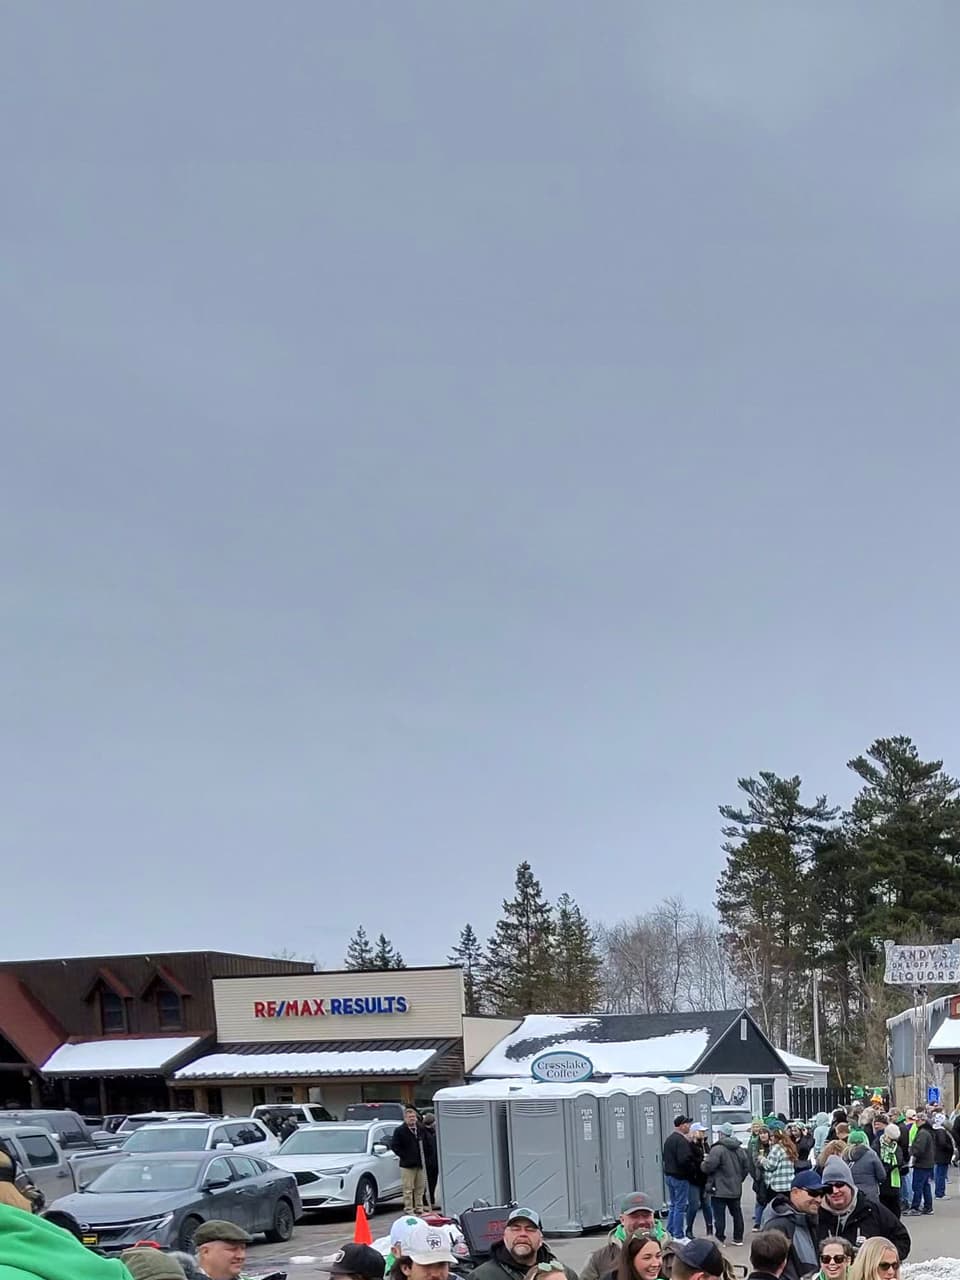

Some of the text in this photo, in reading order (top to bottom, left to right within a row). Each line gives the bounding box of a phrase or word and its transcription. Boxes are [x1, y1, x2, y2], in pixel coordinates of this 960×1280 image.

[913, 961, 929, 969] OFF
[891, 970, 956, 981] LIQUORS
[254, 996, 408, 1018] RE/MAX RESULTS
[537, 1060, 588, 1070] Crosslake
[546, 1069, 579, 1078] Coffee
